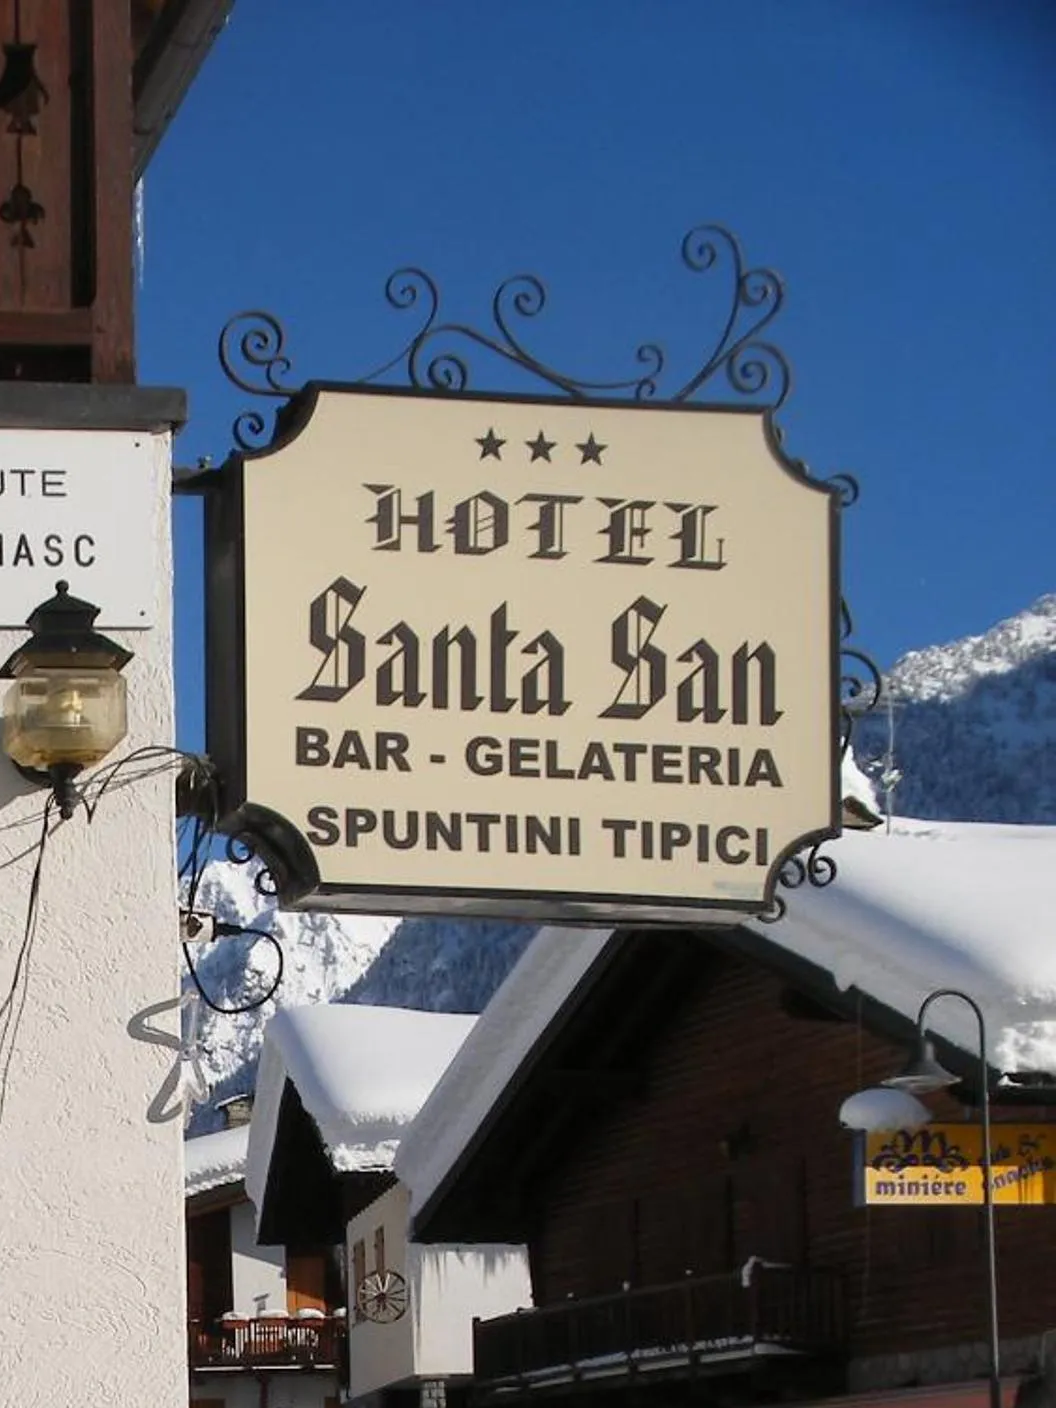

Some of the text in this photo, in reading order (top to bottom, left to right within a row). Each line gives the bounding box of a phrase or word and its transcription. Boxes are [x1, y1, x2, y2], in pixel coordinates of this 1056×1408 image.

[362, 483, 728, 571] HOTEL
[295, 576, 785, 727] Santa San
[295, 726, 412, 773] BAR
[464, 735, 784, 788] GELATERIA
[305, 806, 770, 867] SPUNTINI TIPICI
